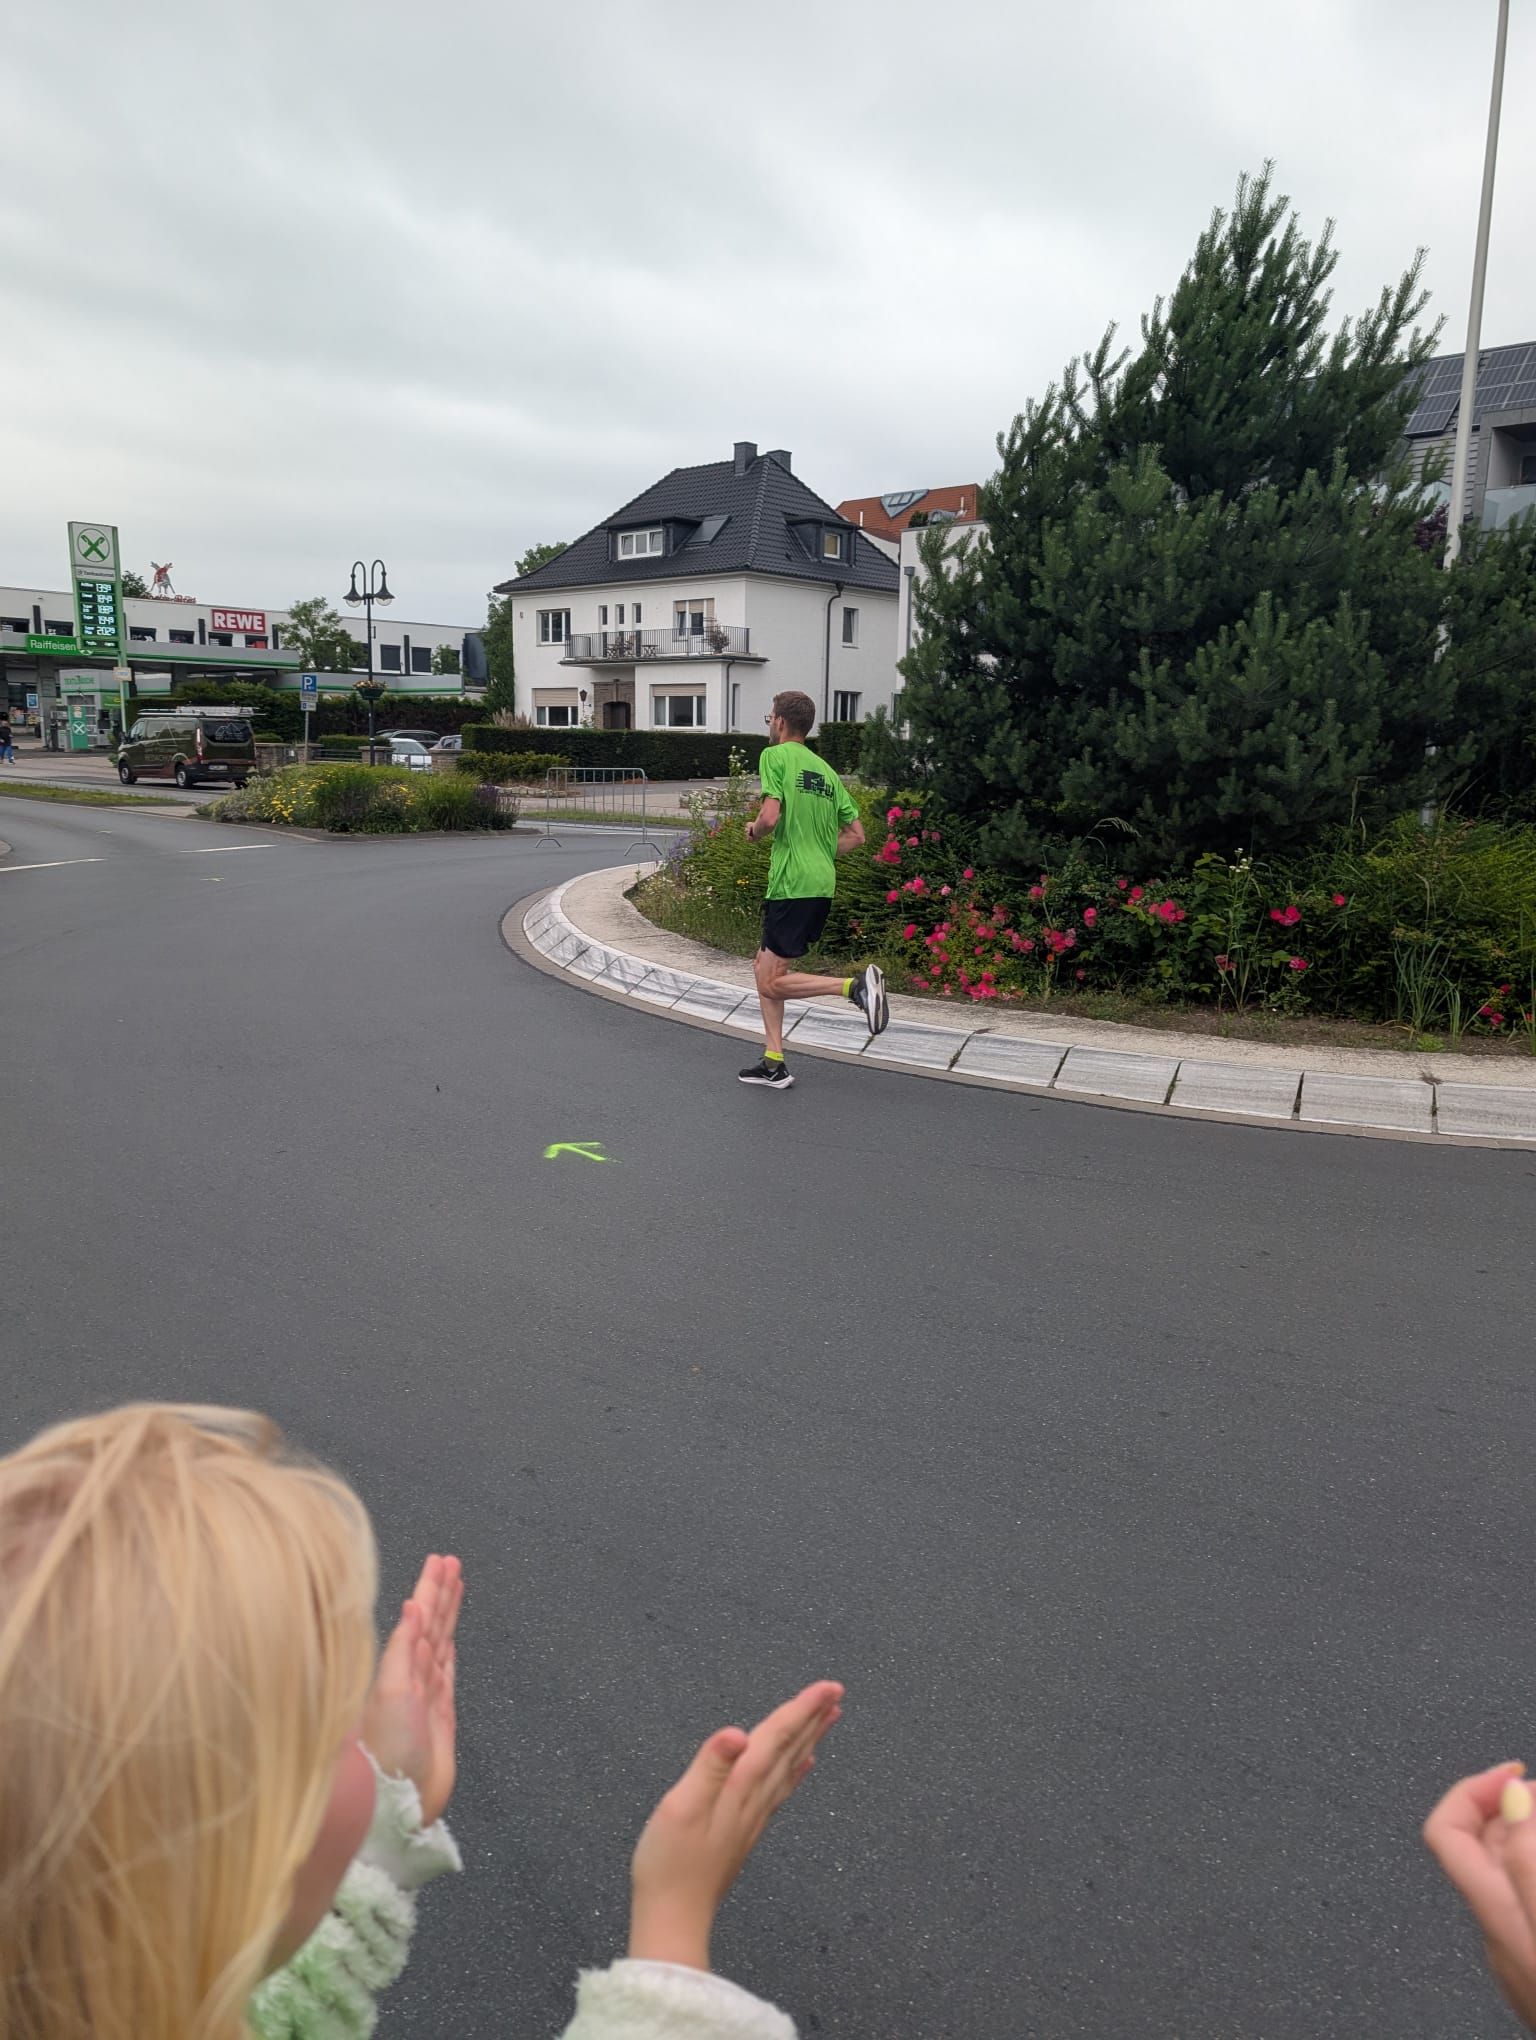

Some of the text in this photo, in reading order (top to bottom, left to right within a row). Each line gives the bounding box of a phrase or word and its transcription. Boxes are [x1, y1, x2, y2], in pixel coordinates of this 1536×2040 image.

[214, 612, 264, 630] REWE
[30, 640, 76, 651] Raiffeisen
[304, 676, 313, 690] P
